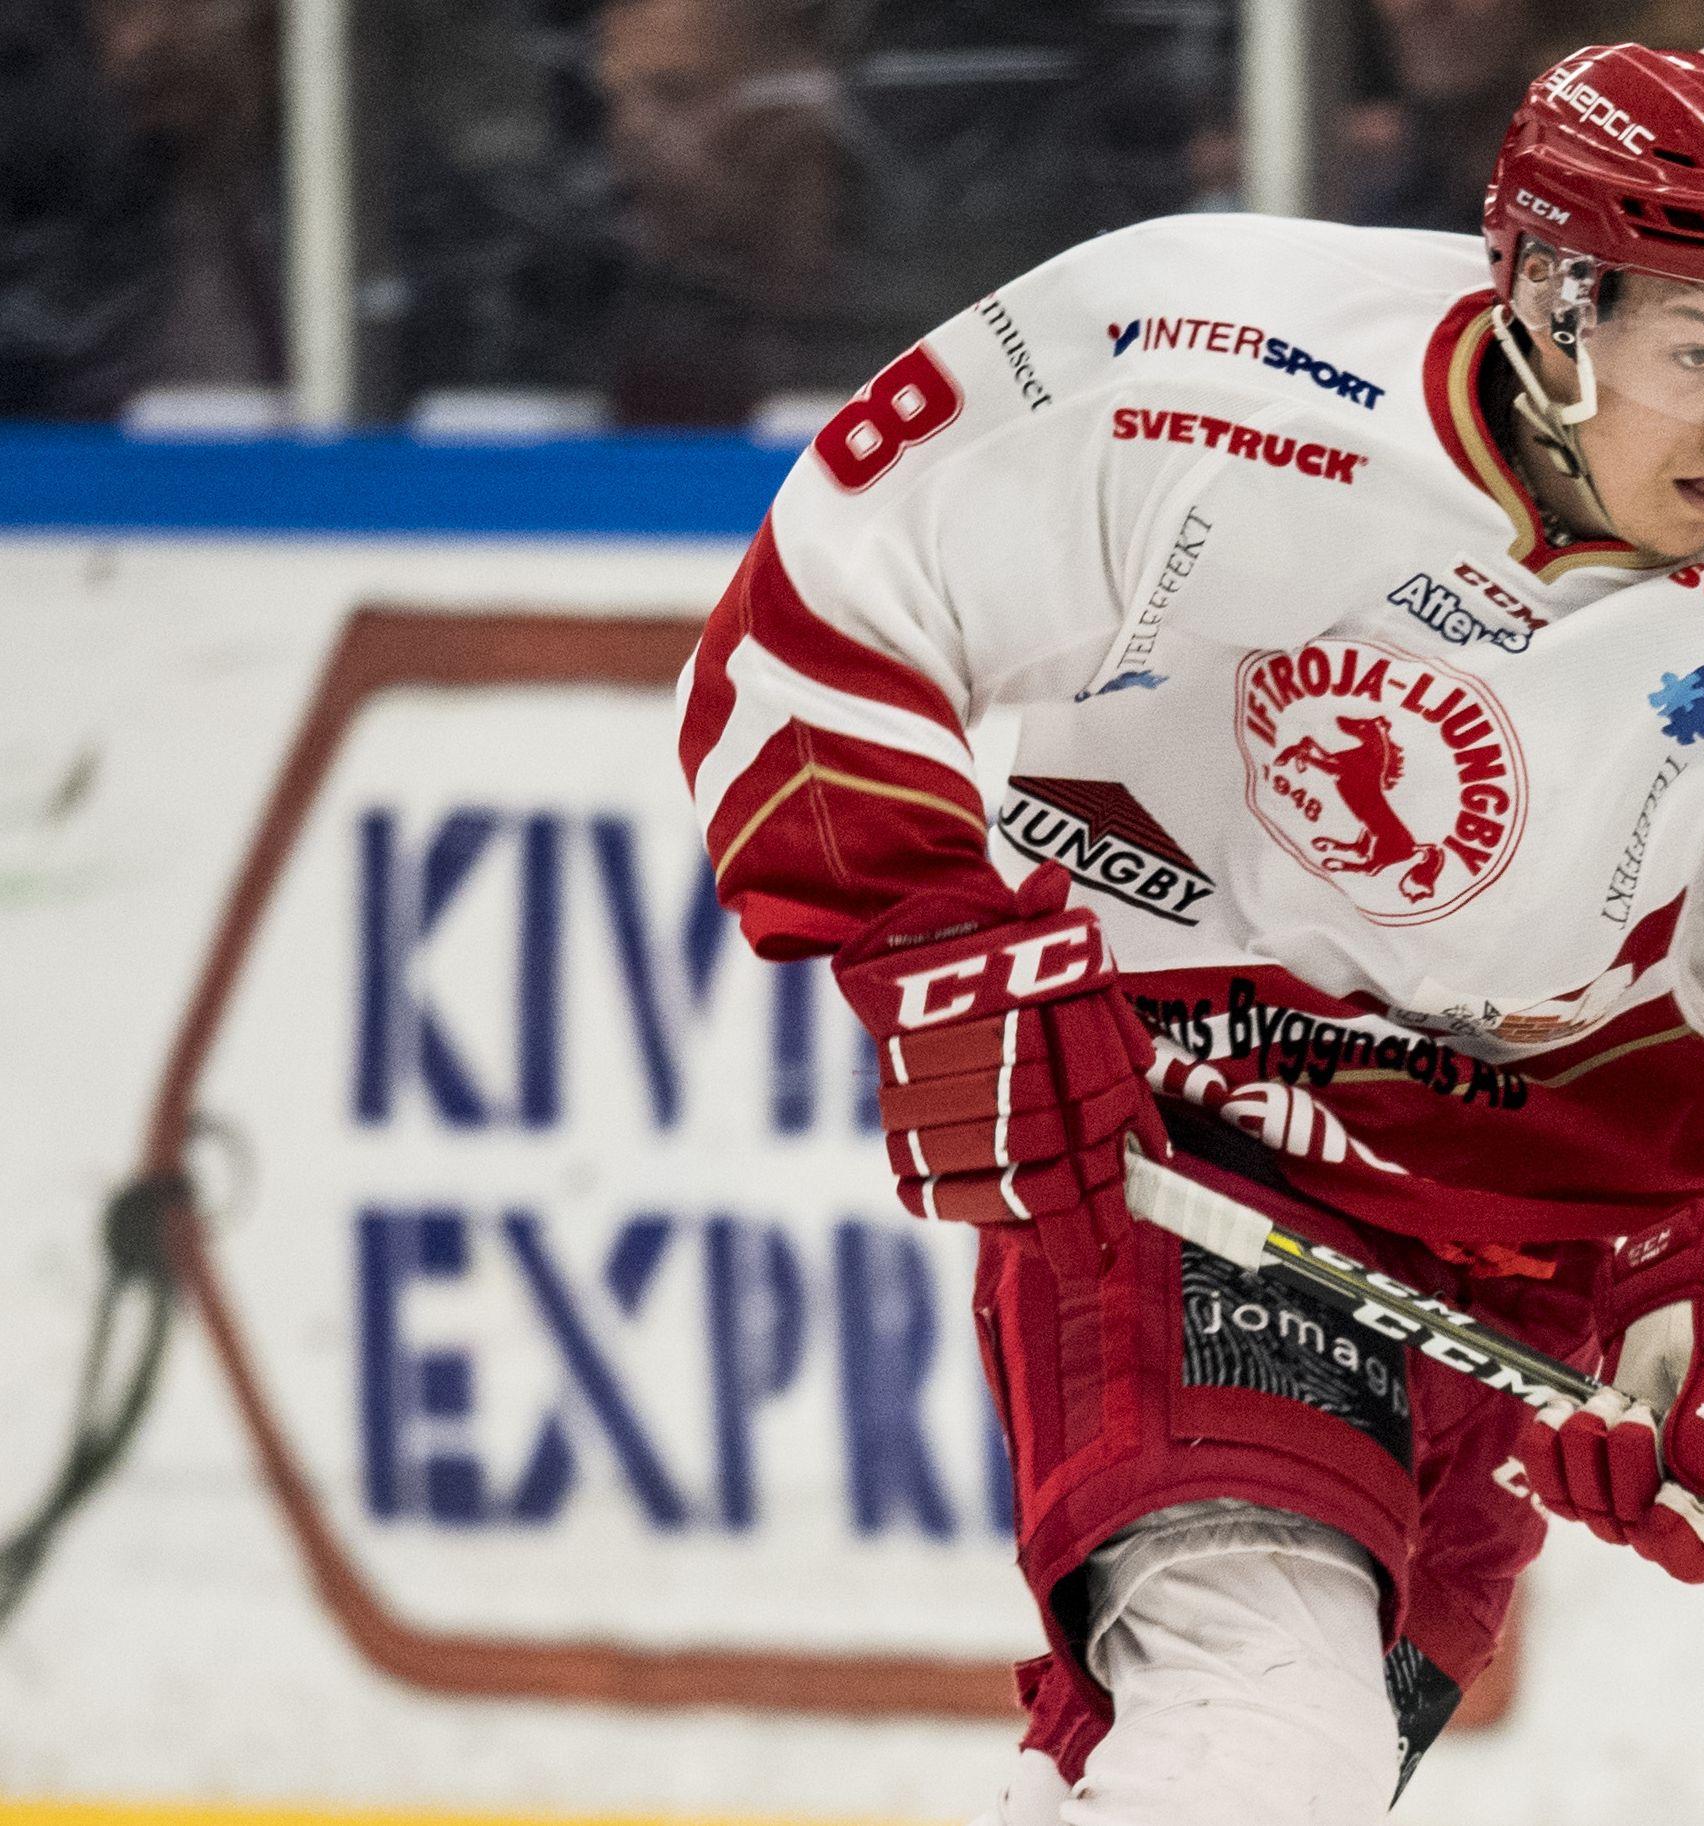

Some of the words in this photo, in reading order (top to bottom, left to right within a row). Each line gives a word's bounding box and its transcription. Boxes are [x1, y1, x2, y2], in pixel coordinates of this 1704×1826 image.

[1515, 188, 1571, 226] CCM
[1141, 317, 1386, 411] INTERSPORT
[809, 339, 965, 496] 8
[1112, 407, 1361, 485] SVETRUCK
[1117, 504, 1213, 670] TELEFFEKT
[1454, 561, 1550, 631] CCM
[1251, 646, 1511, 877] TROJA-LJUNGBY
[1262, 763, 1323, 823] 1948
[896, 921, 1114, 1029] CC
[1310, 1243, 1475, 1327] CCM
[352, 1208, 1020, 1543] EXPR
[1352, 1297, 1556, 1409] CCM
